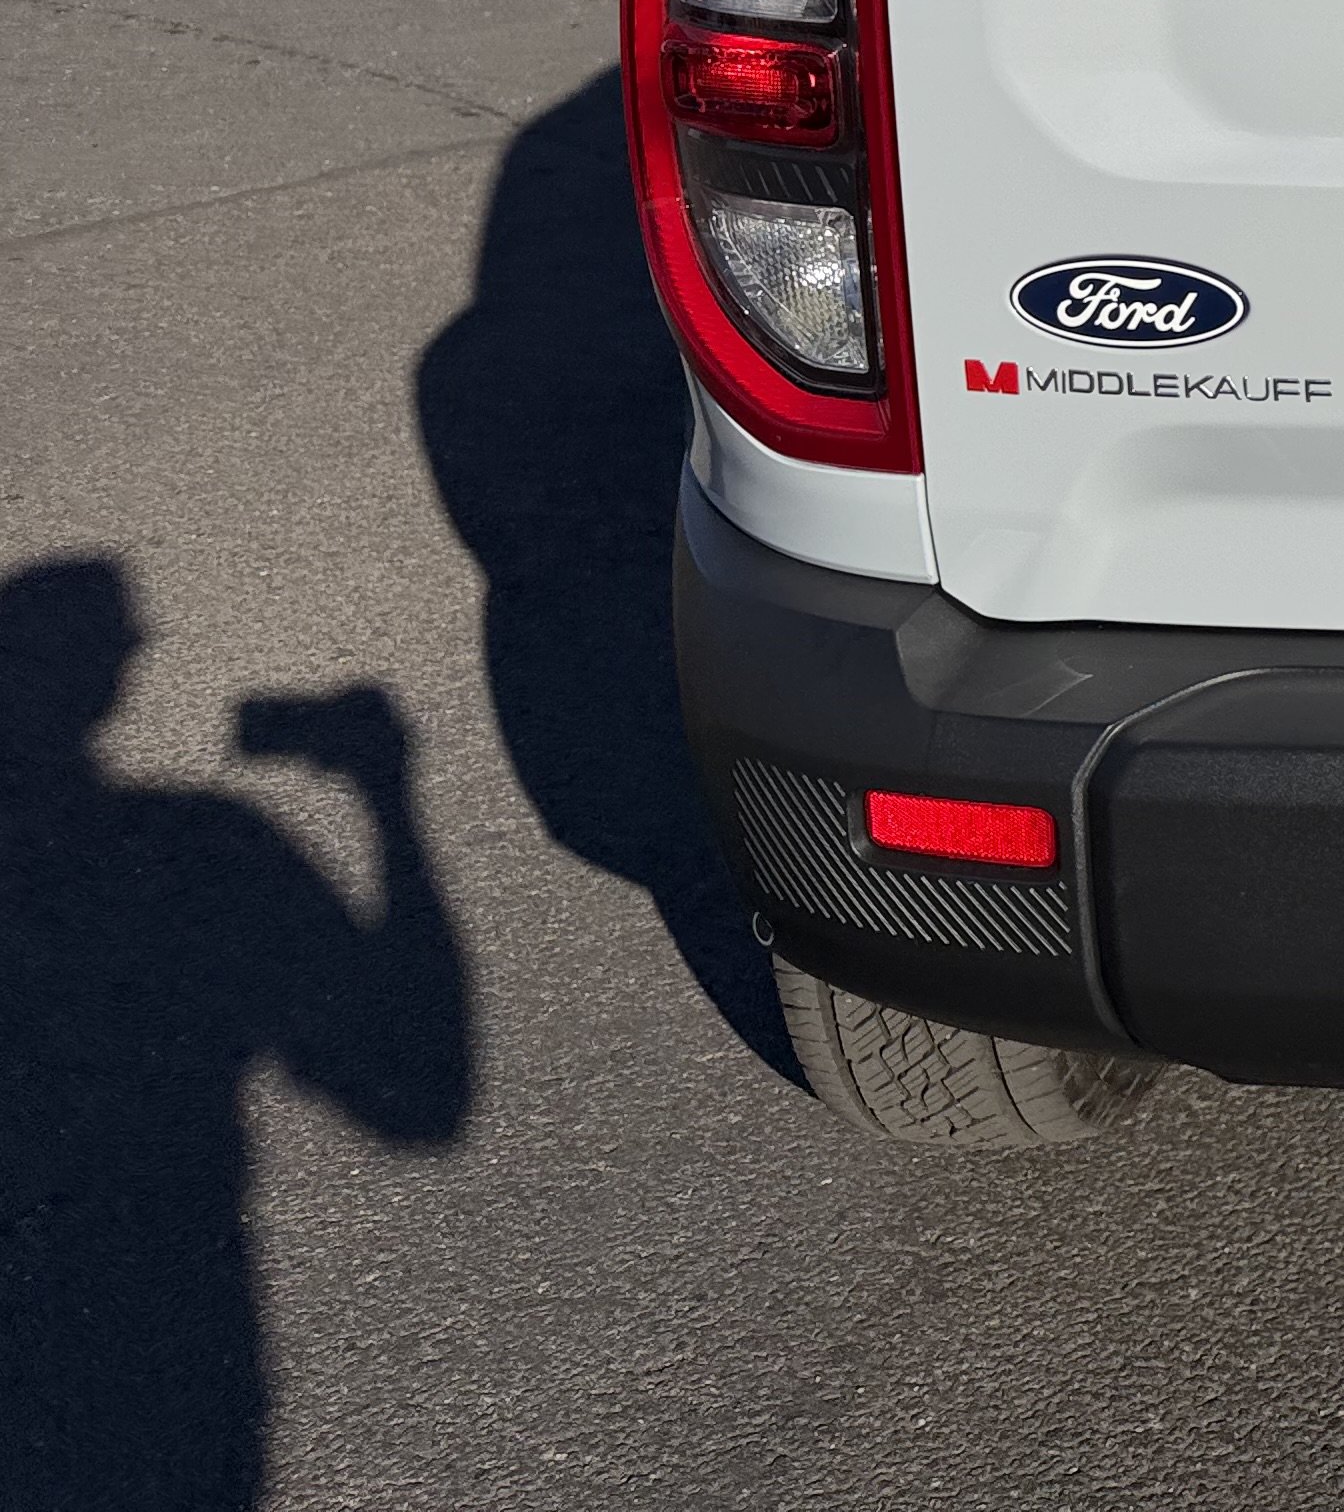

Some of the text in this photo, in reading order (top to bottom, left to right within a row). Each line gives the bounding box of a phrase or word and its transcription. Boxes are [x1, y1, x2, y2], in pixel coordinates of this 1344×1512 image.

[1056, 272, 1199, 333] Ford
[964, 359, 1334, 402] M MIDDLEKAUFF
